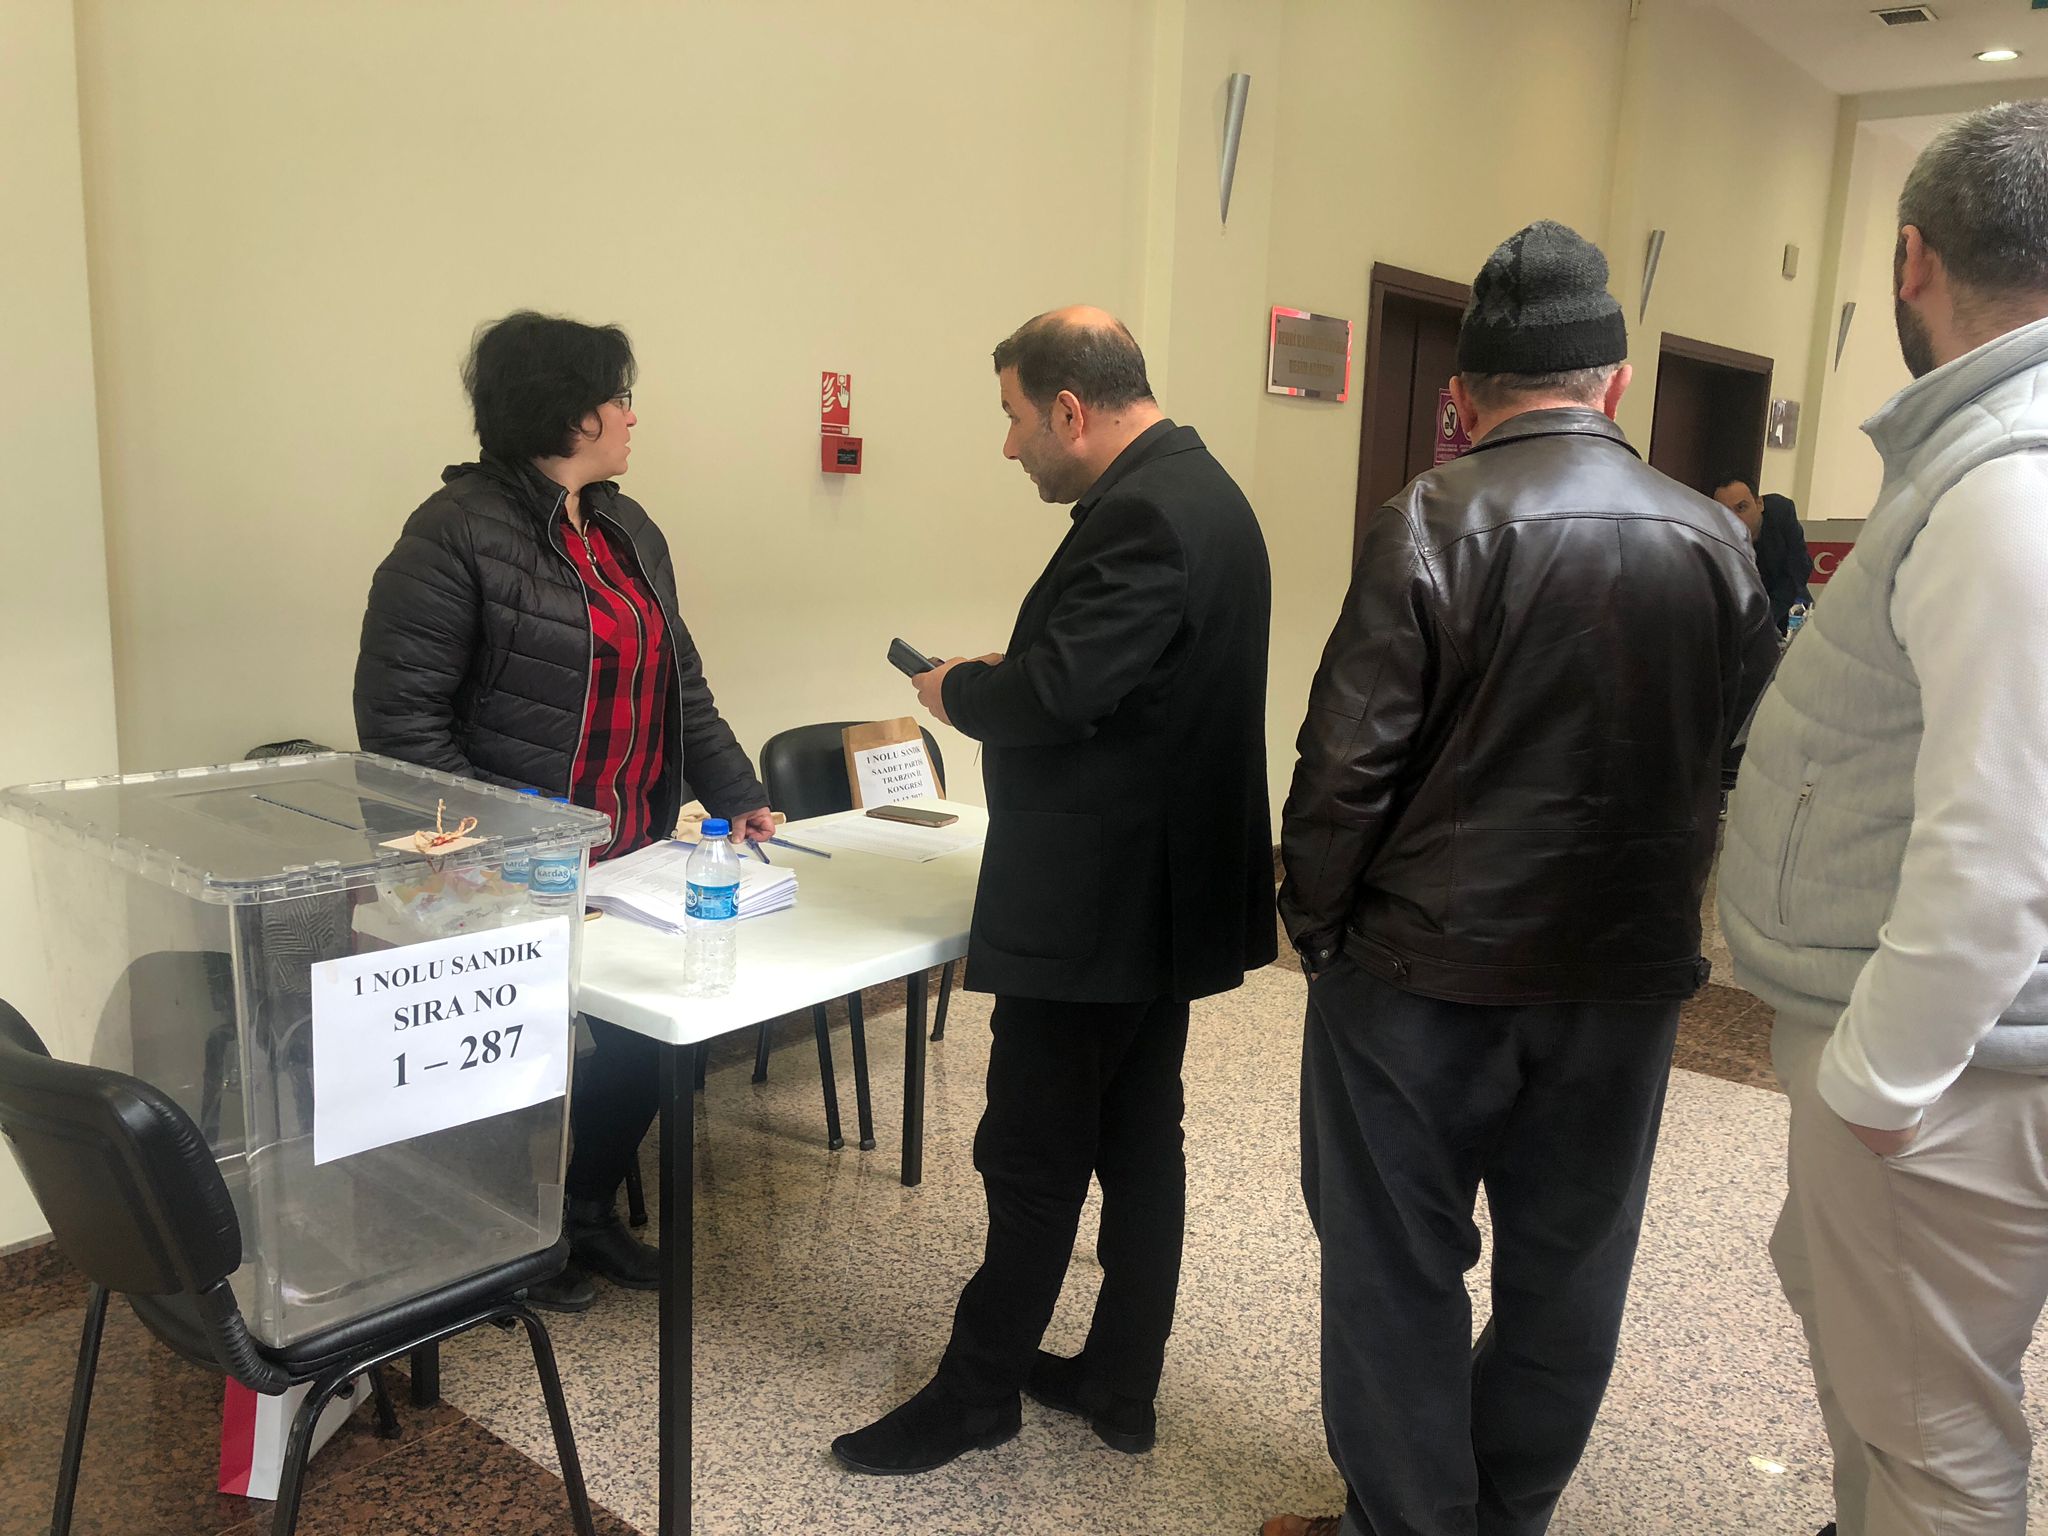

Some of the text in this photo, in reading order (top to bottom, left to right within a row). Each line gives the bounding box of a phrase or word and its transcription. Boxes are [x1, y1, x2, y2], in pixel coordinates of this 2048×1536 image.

[872, 764, 902, 776] SAADET
[873, 751, 899, 763] NOLU
[882, 771, 916, 784] TRABZON
[354, 940, 544, 997] 1 NOLU SANDIK
[393, 983, 518, 1032] SIRA NO
[393, 1052, 411, 1089] 1
[459, 1024, 524, 1071] 287
